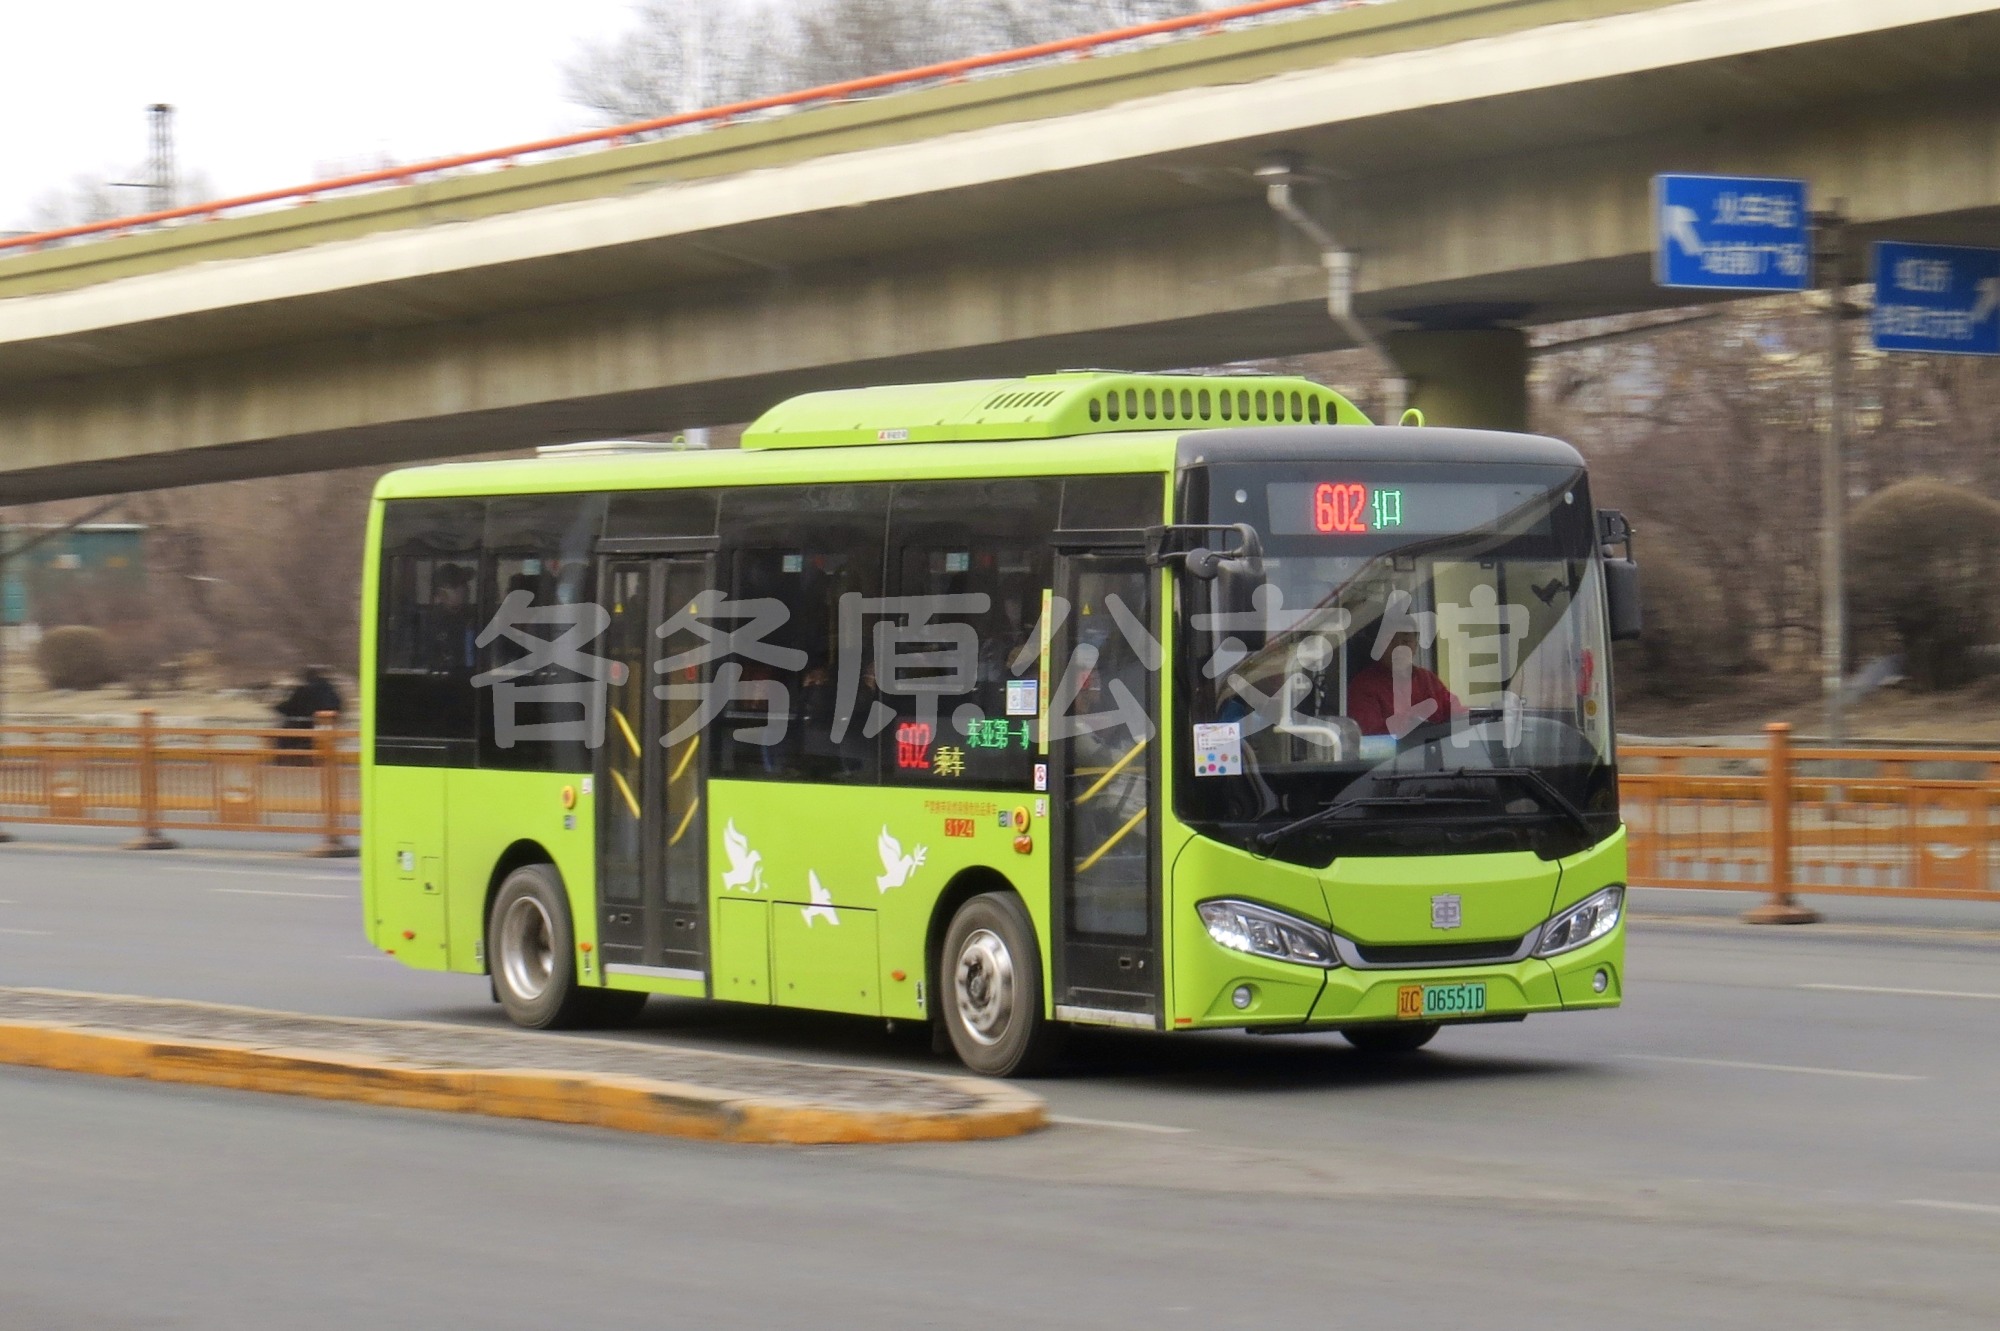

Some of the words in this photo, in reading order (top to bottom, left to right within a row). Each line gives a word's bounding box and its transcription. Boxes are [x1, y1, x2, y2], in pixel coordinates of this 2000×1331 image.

[1315, 483, 1366, 533] 602
[898, 721, 930, 769] 602
[945, 819, 973, 837] 3124
